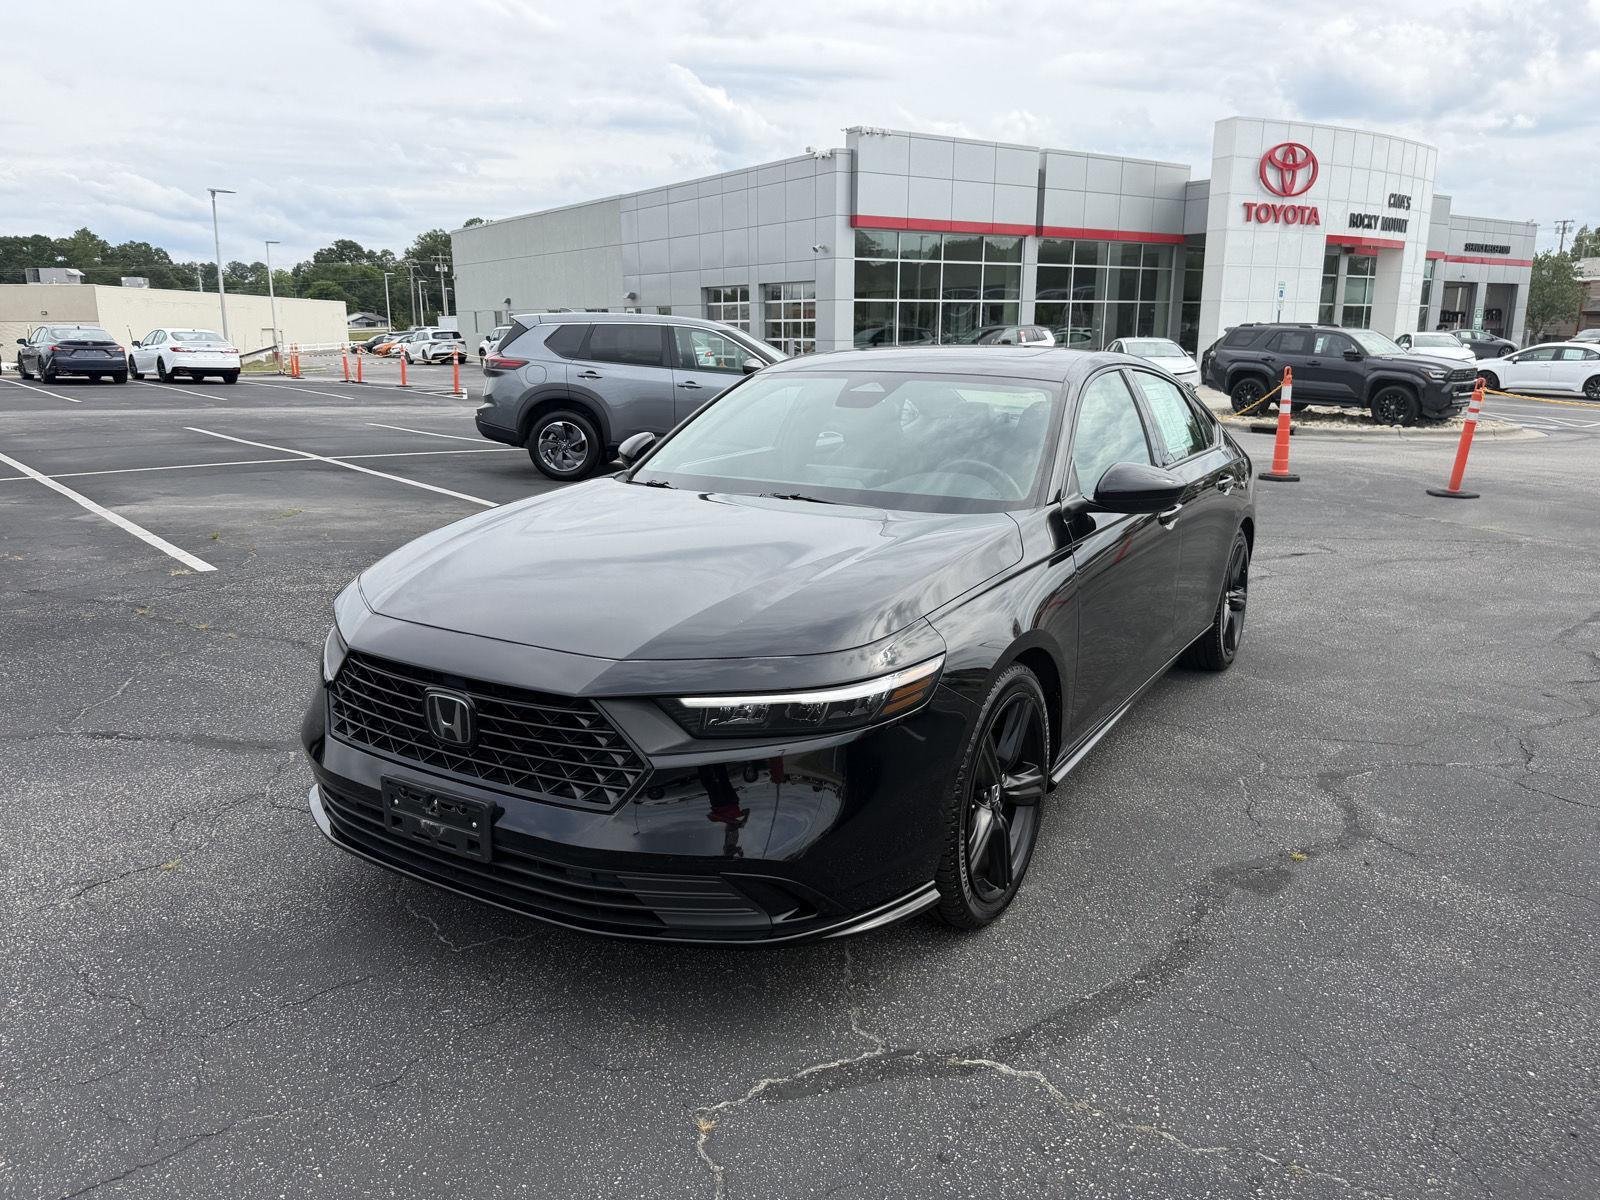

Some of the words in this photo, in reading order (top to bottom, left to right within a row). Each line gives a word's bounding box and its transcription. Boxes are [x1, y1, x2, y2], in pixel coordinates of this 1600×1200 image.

[1243, 203, 1320, 225] TOYOTA
[1349, 213, 1380, 230] ROCKY
[1381, 216, 1409, 233] MOUNT
